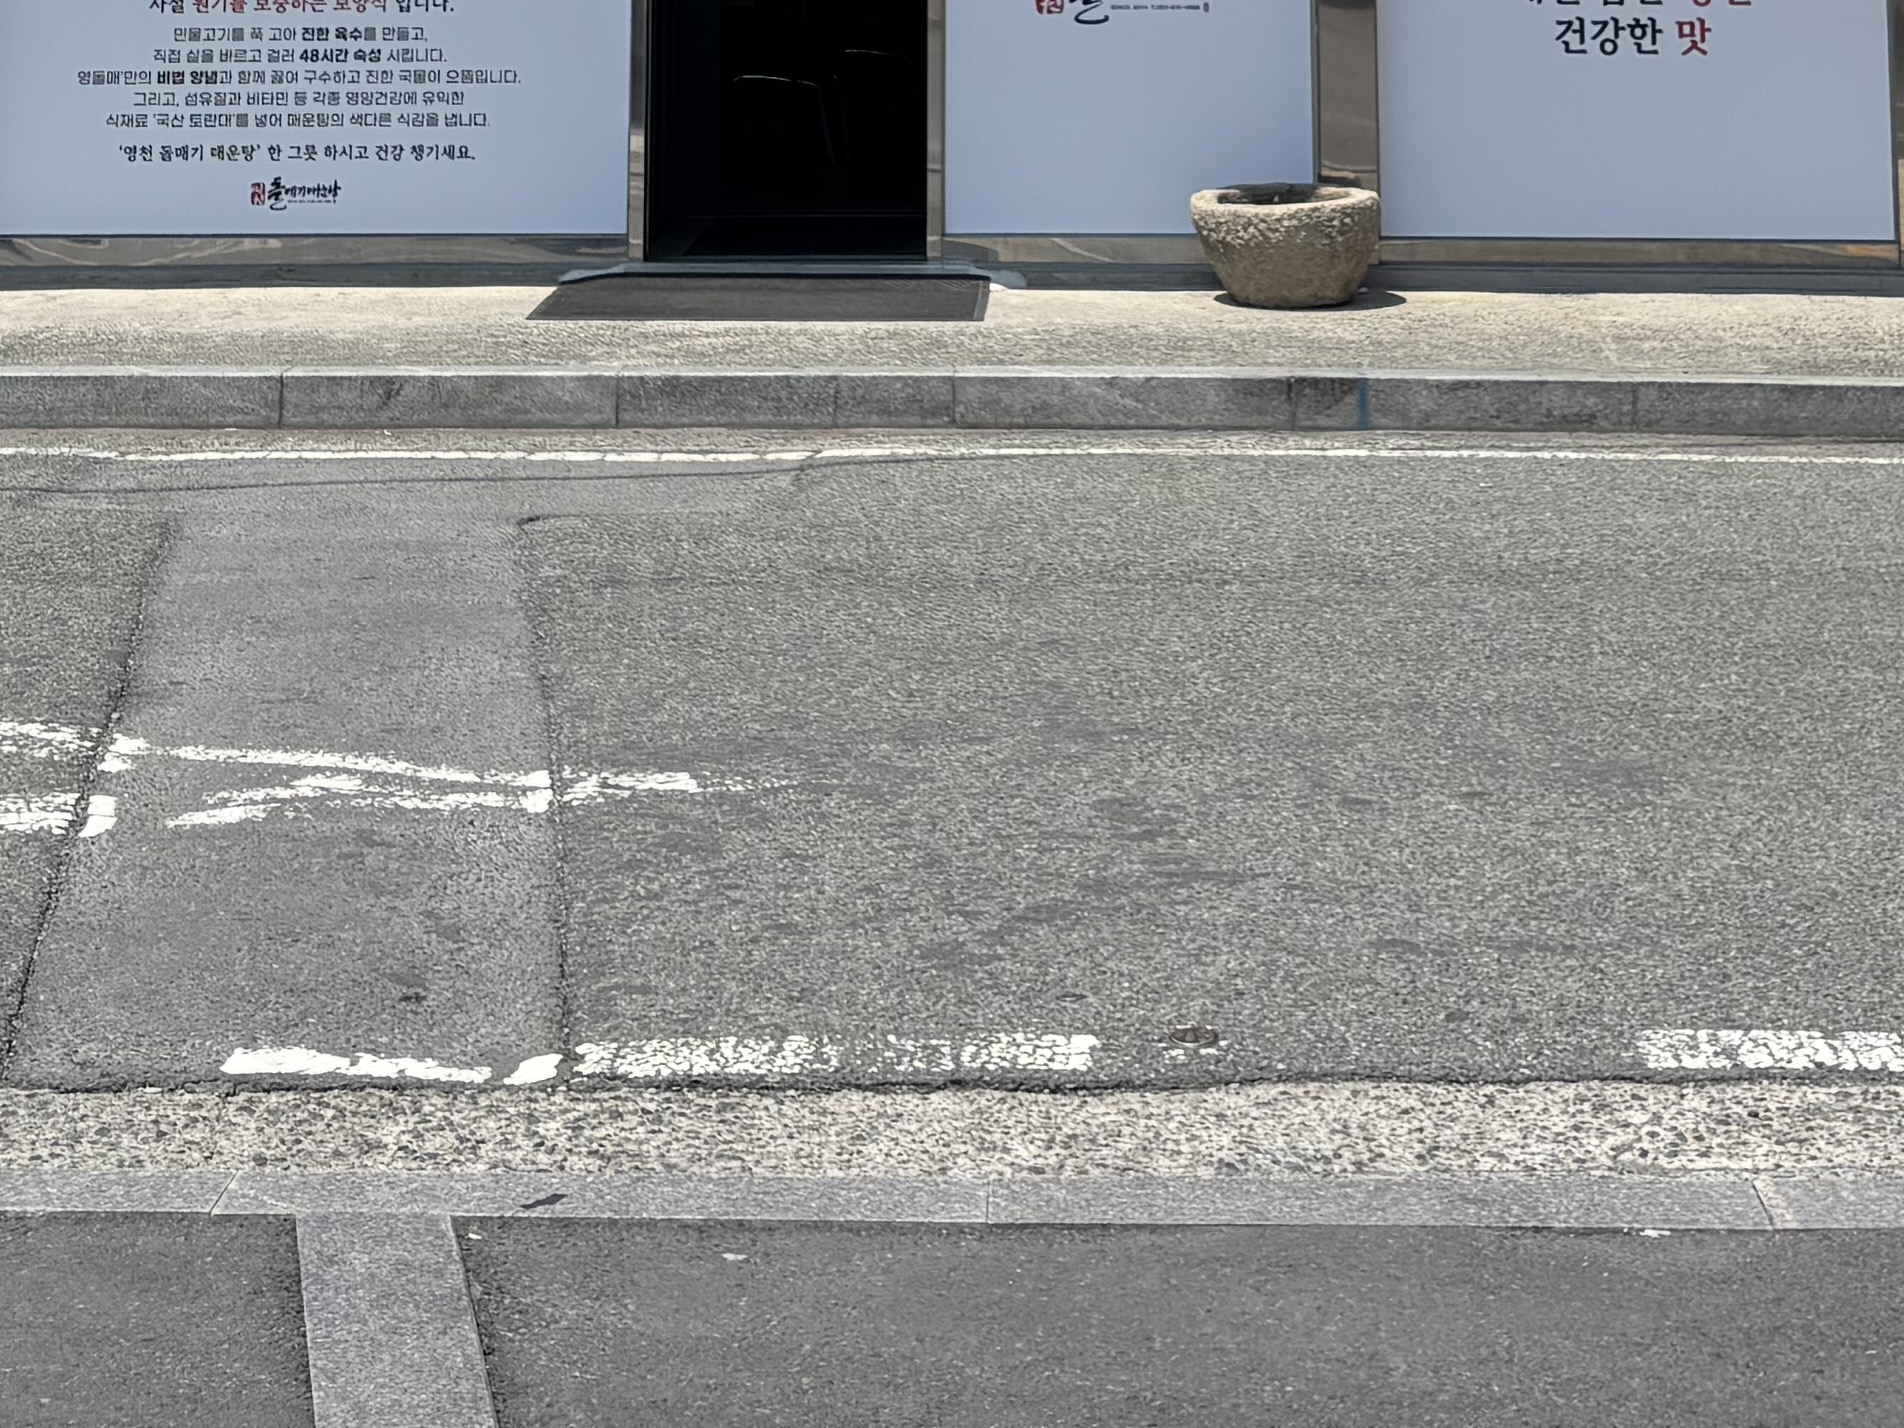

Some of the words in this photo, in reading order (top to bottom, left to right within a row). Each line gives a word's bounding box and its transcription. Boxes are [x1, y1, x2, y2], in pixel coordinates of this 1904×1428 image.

[174, 27, 244, 42] 민물고기를
[268, 27, 297, 41] 고아
[301, 27, 330, 41] 진한
[1555, 16, 1663, 56] 건강한
[1675, 17, 1712, 56] 맛
[154, 49, 181, 64] 직접
[219, 49, 262, 63] 바르고
[299, 48, 349, 63] 48시간
[303, 70, 360, 85] 구수하고
[365, 69, 394, 84] 진한
[133, 92, 179, 107] 그리고,
[247, 91, 288, 106] 비타민
[106, 113, 148, 128] 식재료
[267, 144, 283, 162] 한
[324, 144, 369, 161] 하시고
[375, 144, 405, 162] 건강
